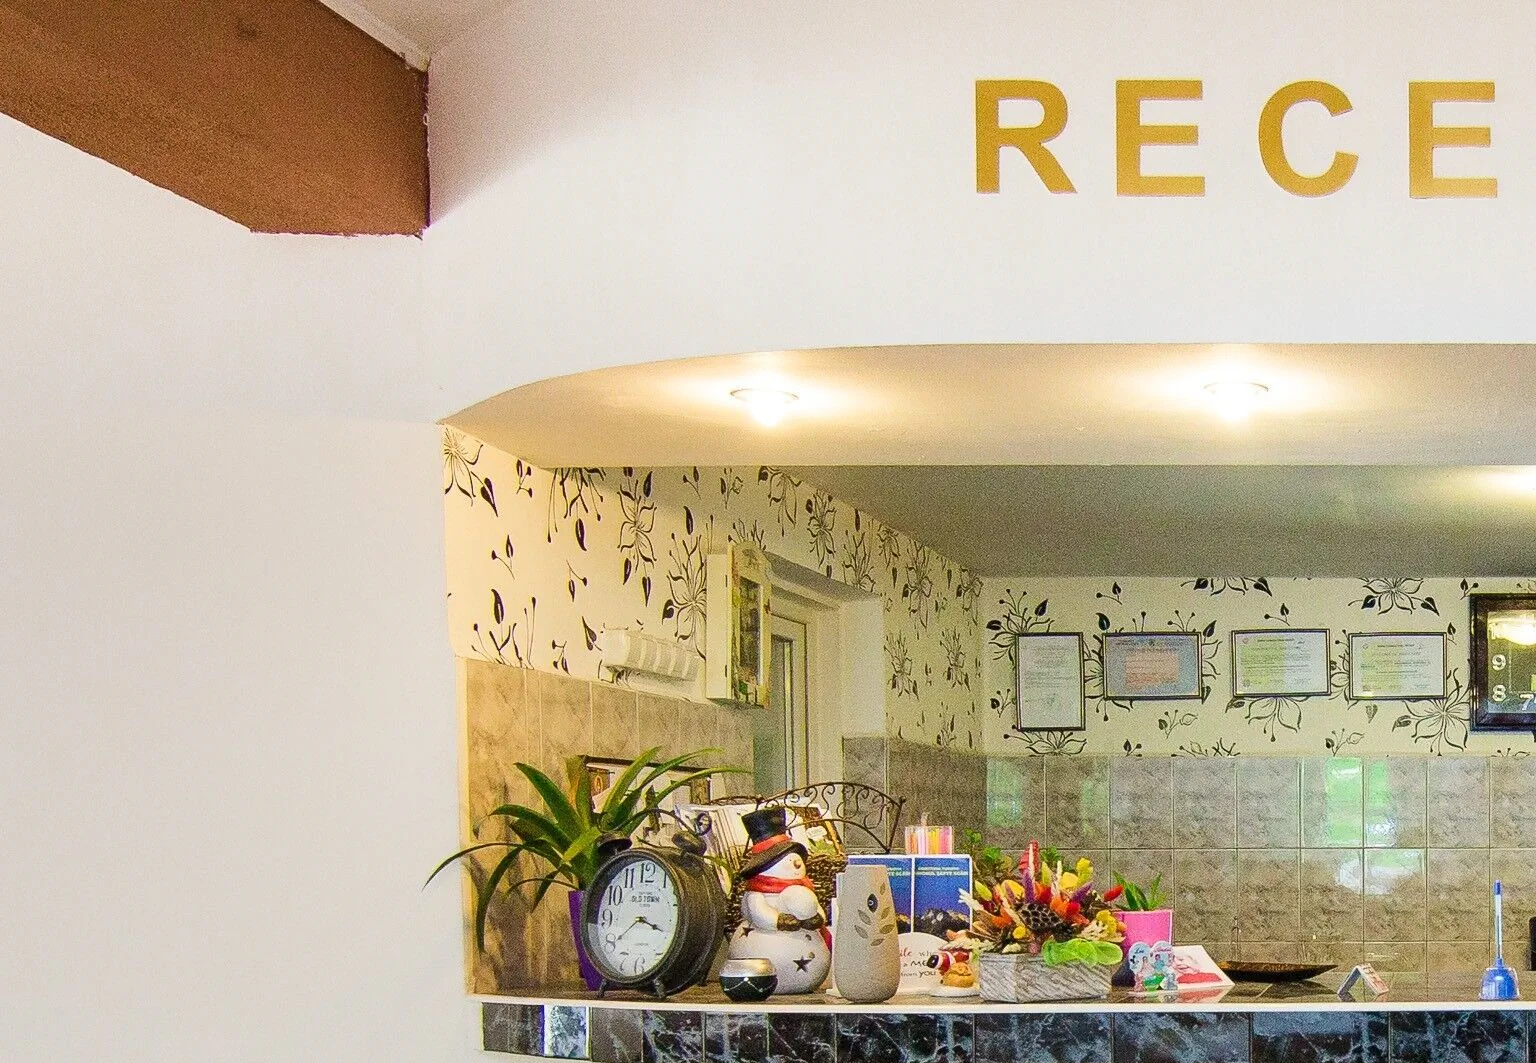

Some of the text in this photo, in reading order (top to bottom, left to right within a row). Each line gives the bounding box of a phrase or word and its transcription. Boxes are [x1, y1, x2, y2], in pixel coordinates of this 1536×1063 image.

[1491, 653, 1507, 671] 9
[1492, 684, 1507, 702] 8
[1519, 693, 1535, 711] 7
[624, 867, 635, 889] 11
[640, 862, 656, 883] 12
[608, 885, 623, 907] 10
[601, 908, 613, 930] 9
[604, 933, 616, 954] 8
